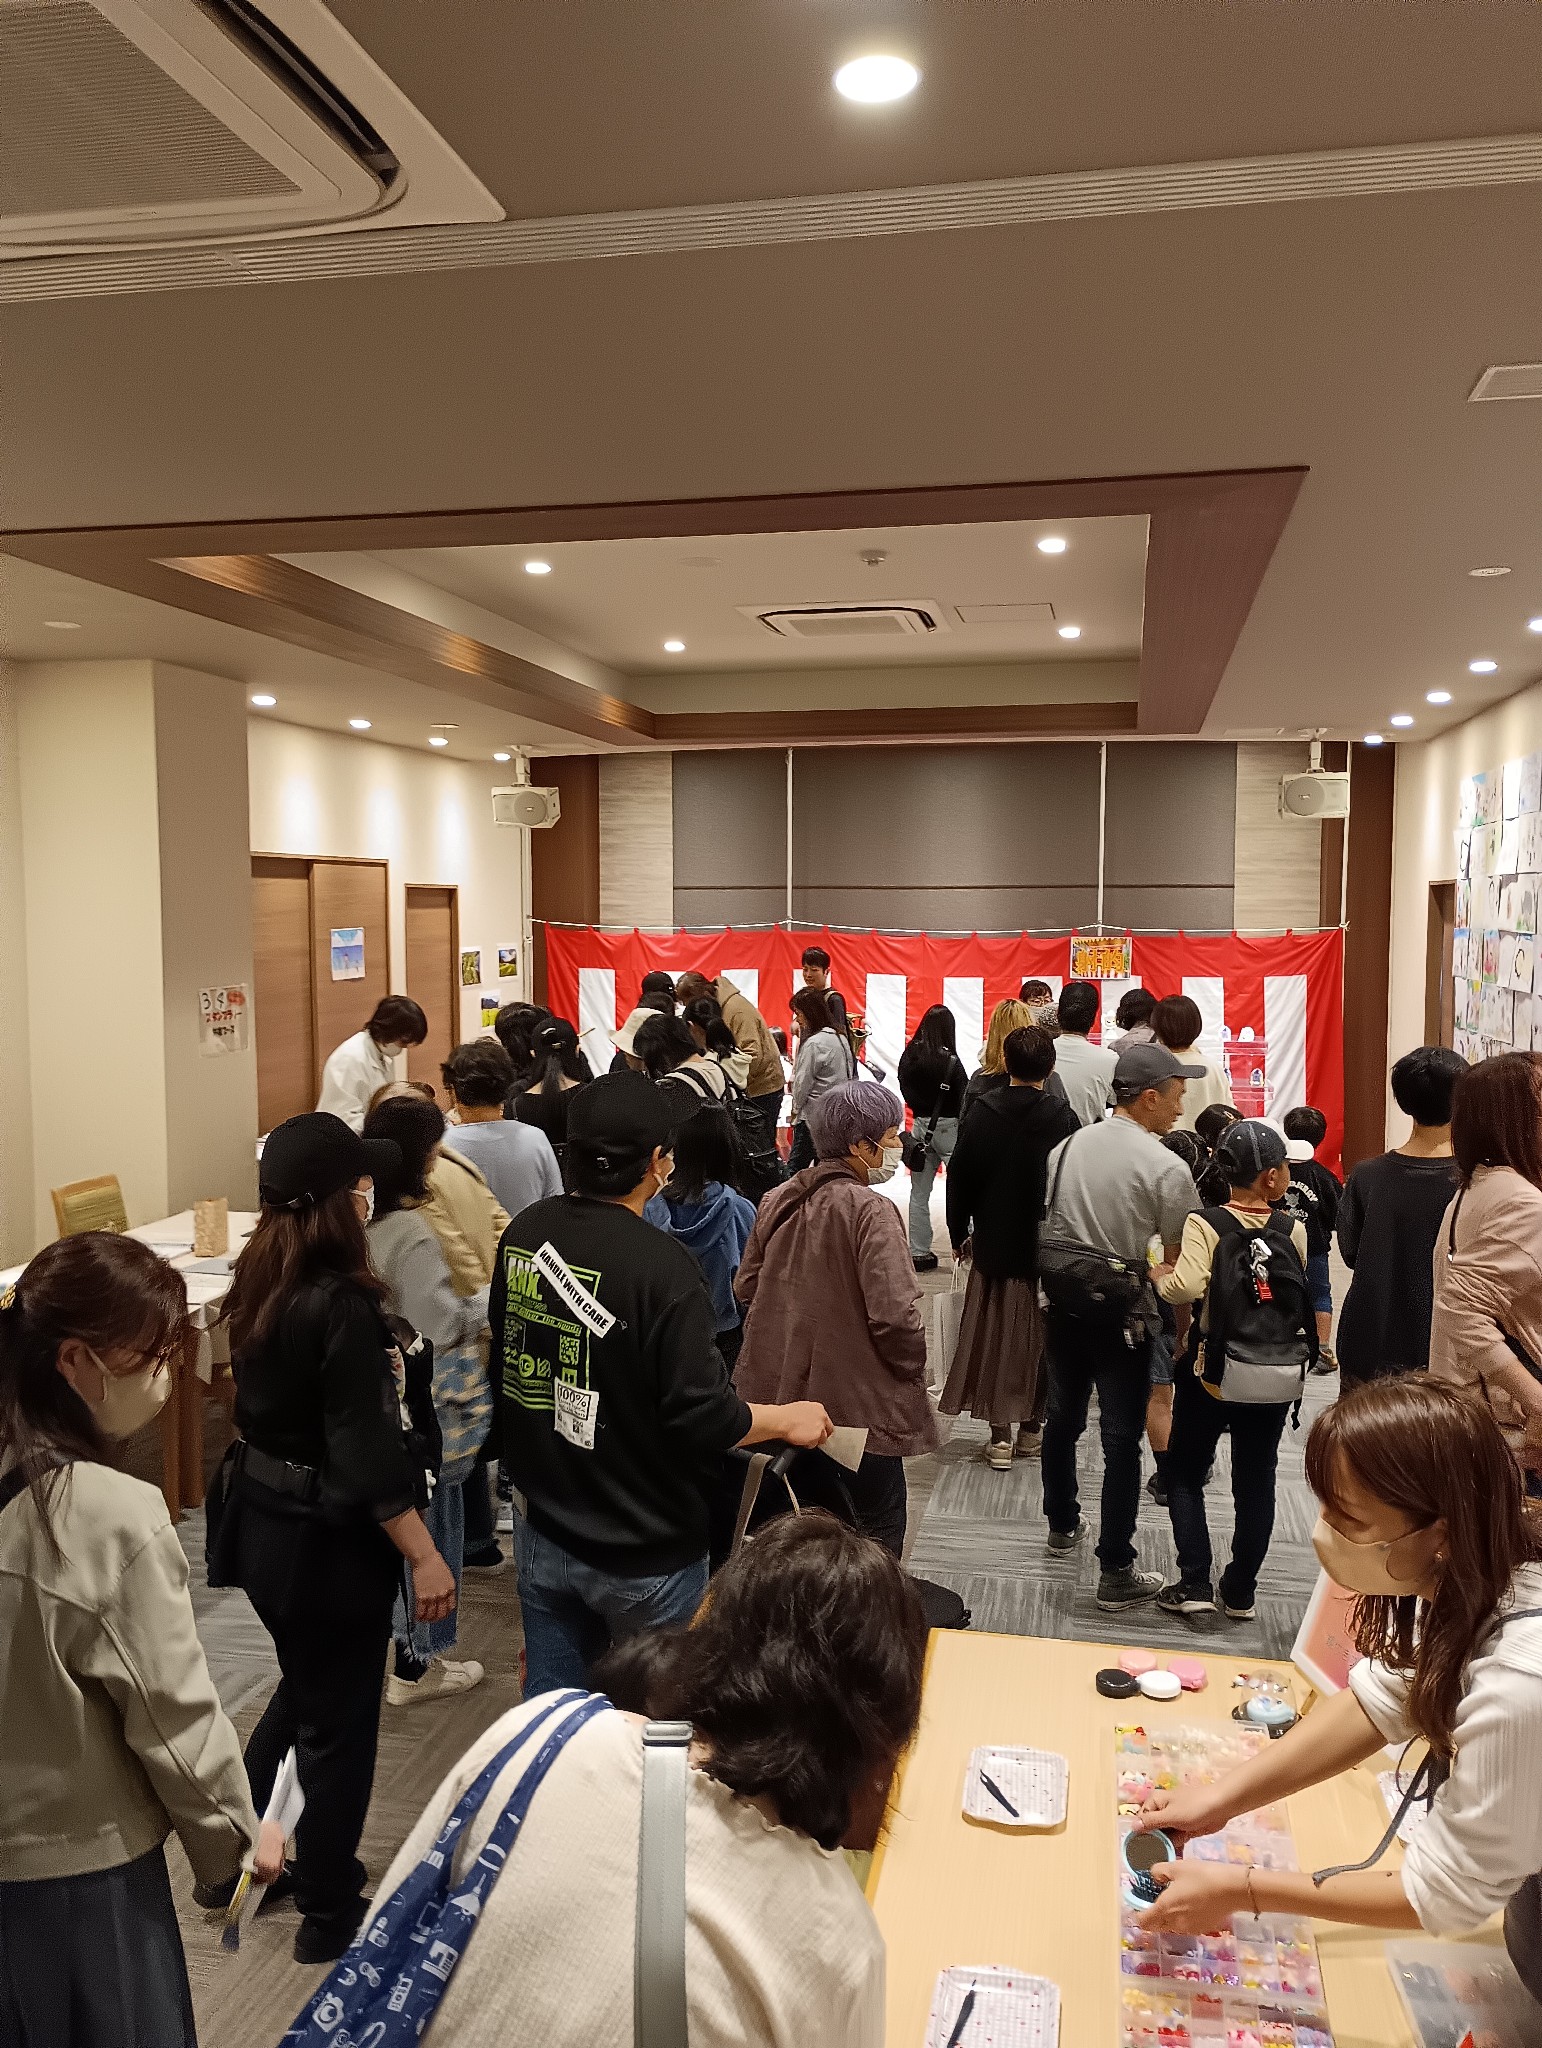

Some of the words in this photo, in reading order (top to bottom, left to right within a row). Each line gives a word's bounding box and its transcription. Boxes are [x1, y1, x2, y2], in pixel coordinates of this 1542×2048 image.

[539, 1249, 567, 1284] HANDLE
[563, 1278, 584, 1307] WITH
[582, 1302, 609, 1330] CARE
[559, 1387, 588, 1408] 100%
